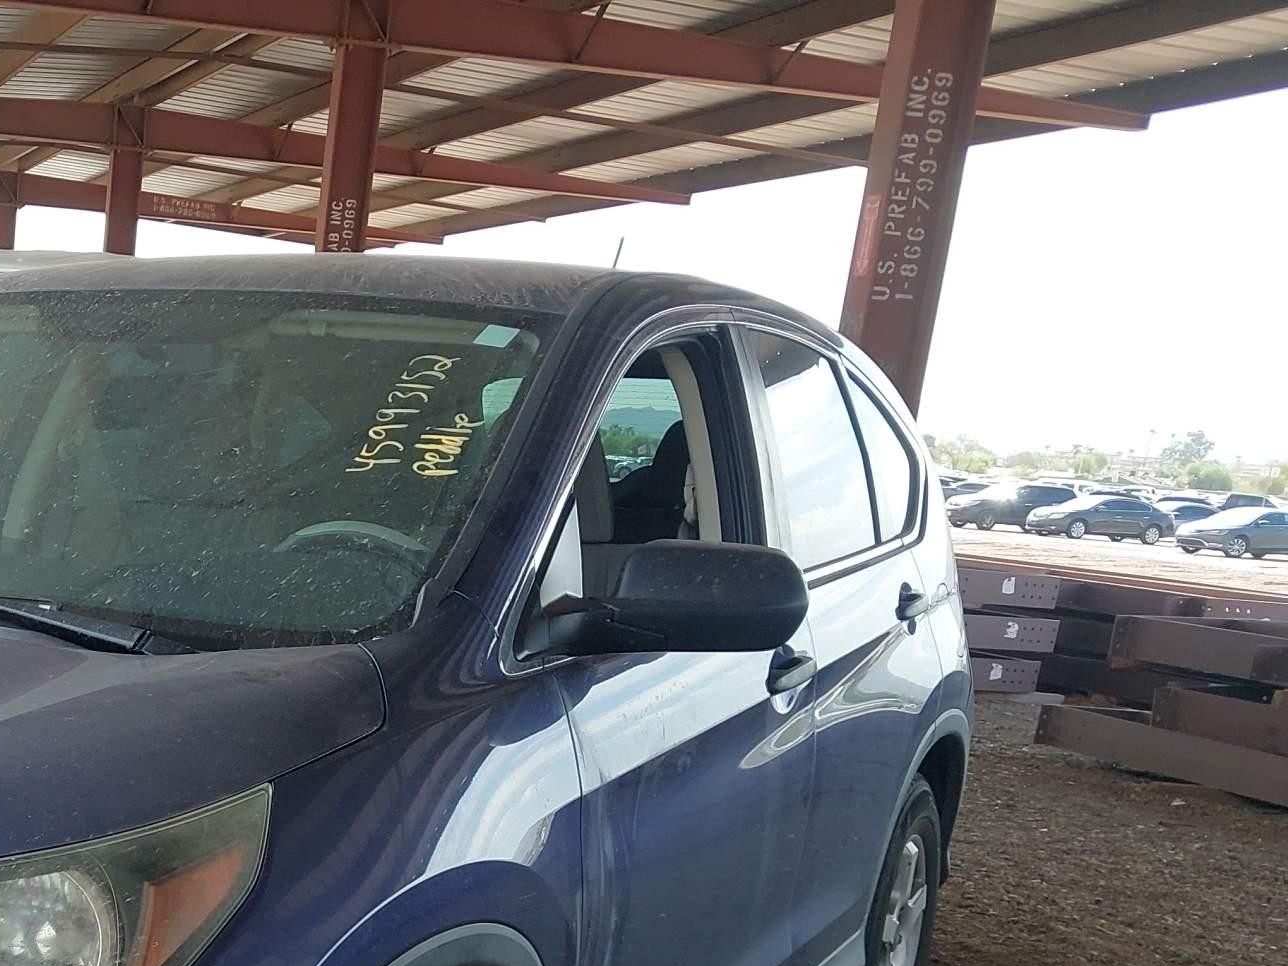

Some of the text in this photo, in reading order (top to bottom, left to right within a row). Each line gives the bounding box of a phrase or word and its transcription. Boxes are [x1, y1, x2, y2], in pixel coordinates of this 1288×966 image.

[330, 198, 345, 225] INC.
[872, 68, 932, 301] U.S. PREFAB INC.
[895, 72, 953, 300] 1-866-799-0969
[345, 354, 462, 472] 45993152
